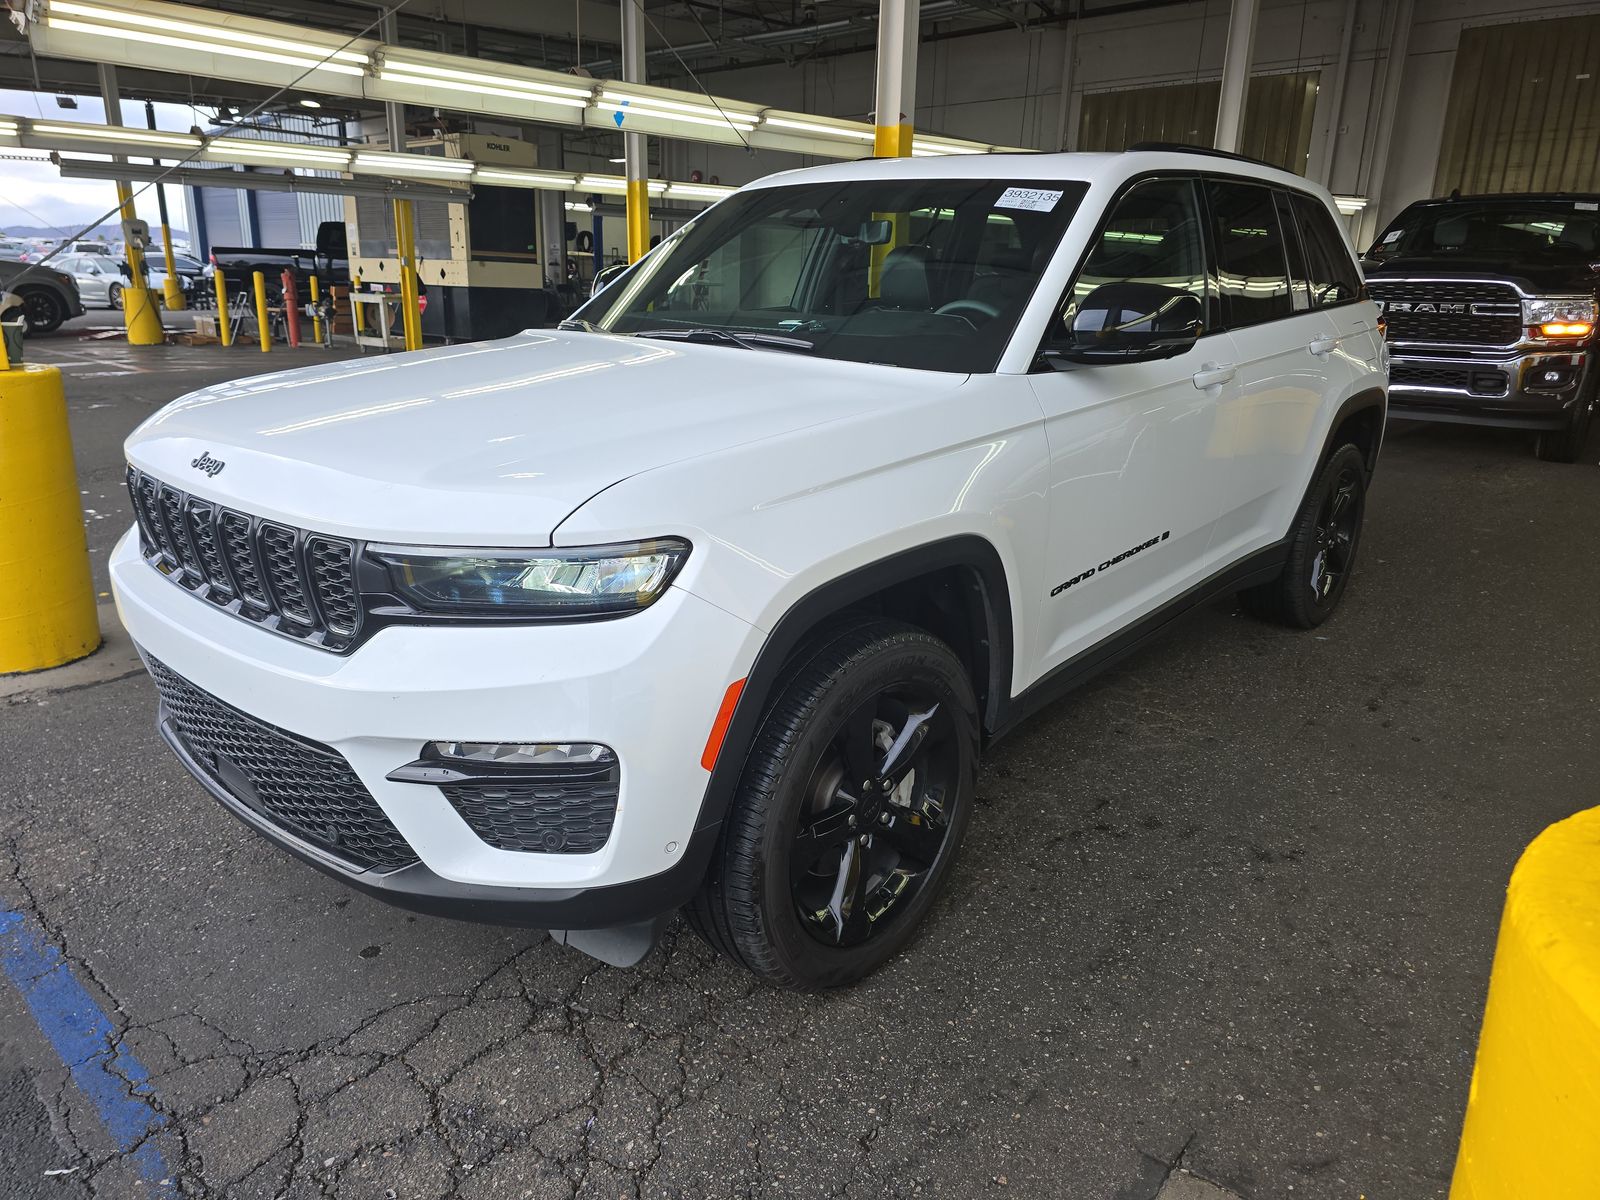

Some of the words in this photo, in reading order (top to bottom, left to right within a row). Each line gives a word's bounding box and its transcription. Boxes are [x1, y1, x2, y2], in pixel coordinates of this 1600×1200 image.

[486, 142, 511, 152] KOHLER
[1004, 189, 1061, 202] 3932135
[1389, 302, 1465, 314] RAM
[191, 451, 226, 478] Jeep
[1050, 568, 1095, 597] GRAND
[1098, 535, 1160, 571] CHEROKEE
